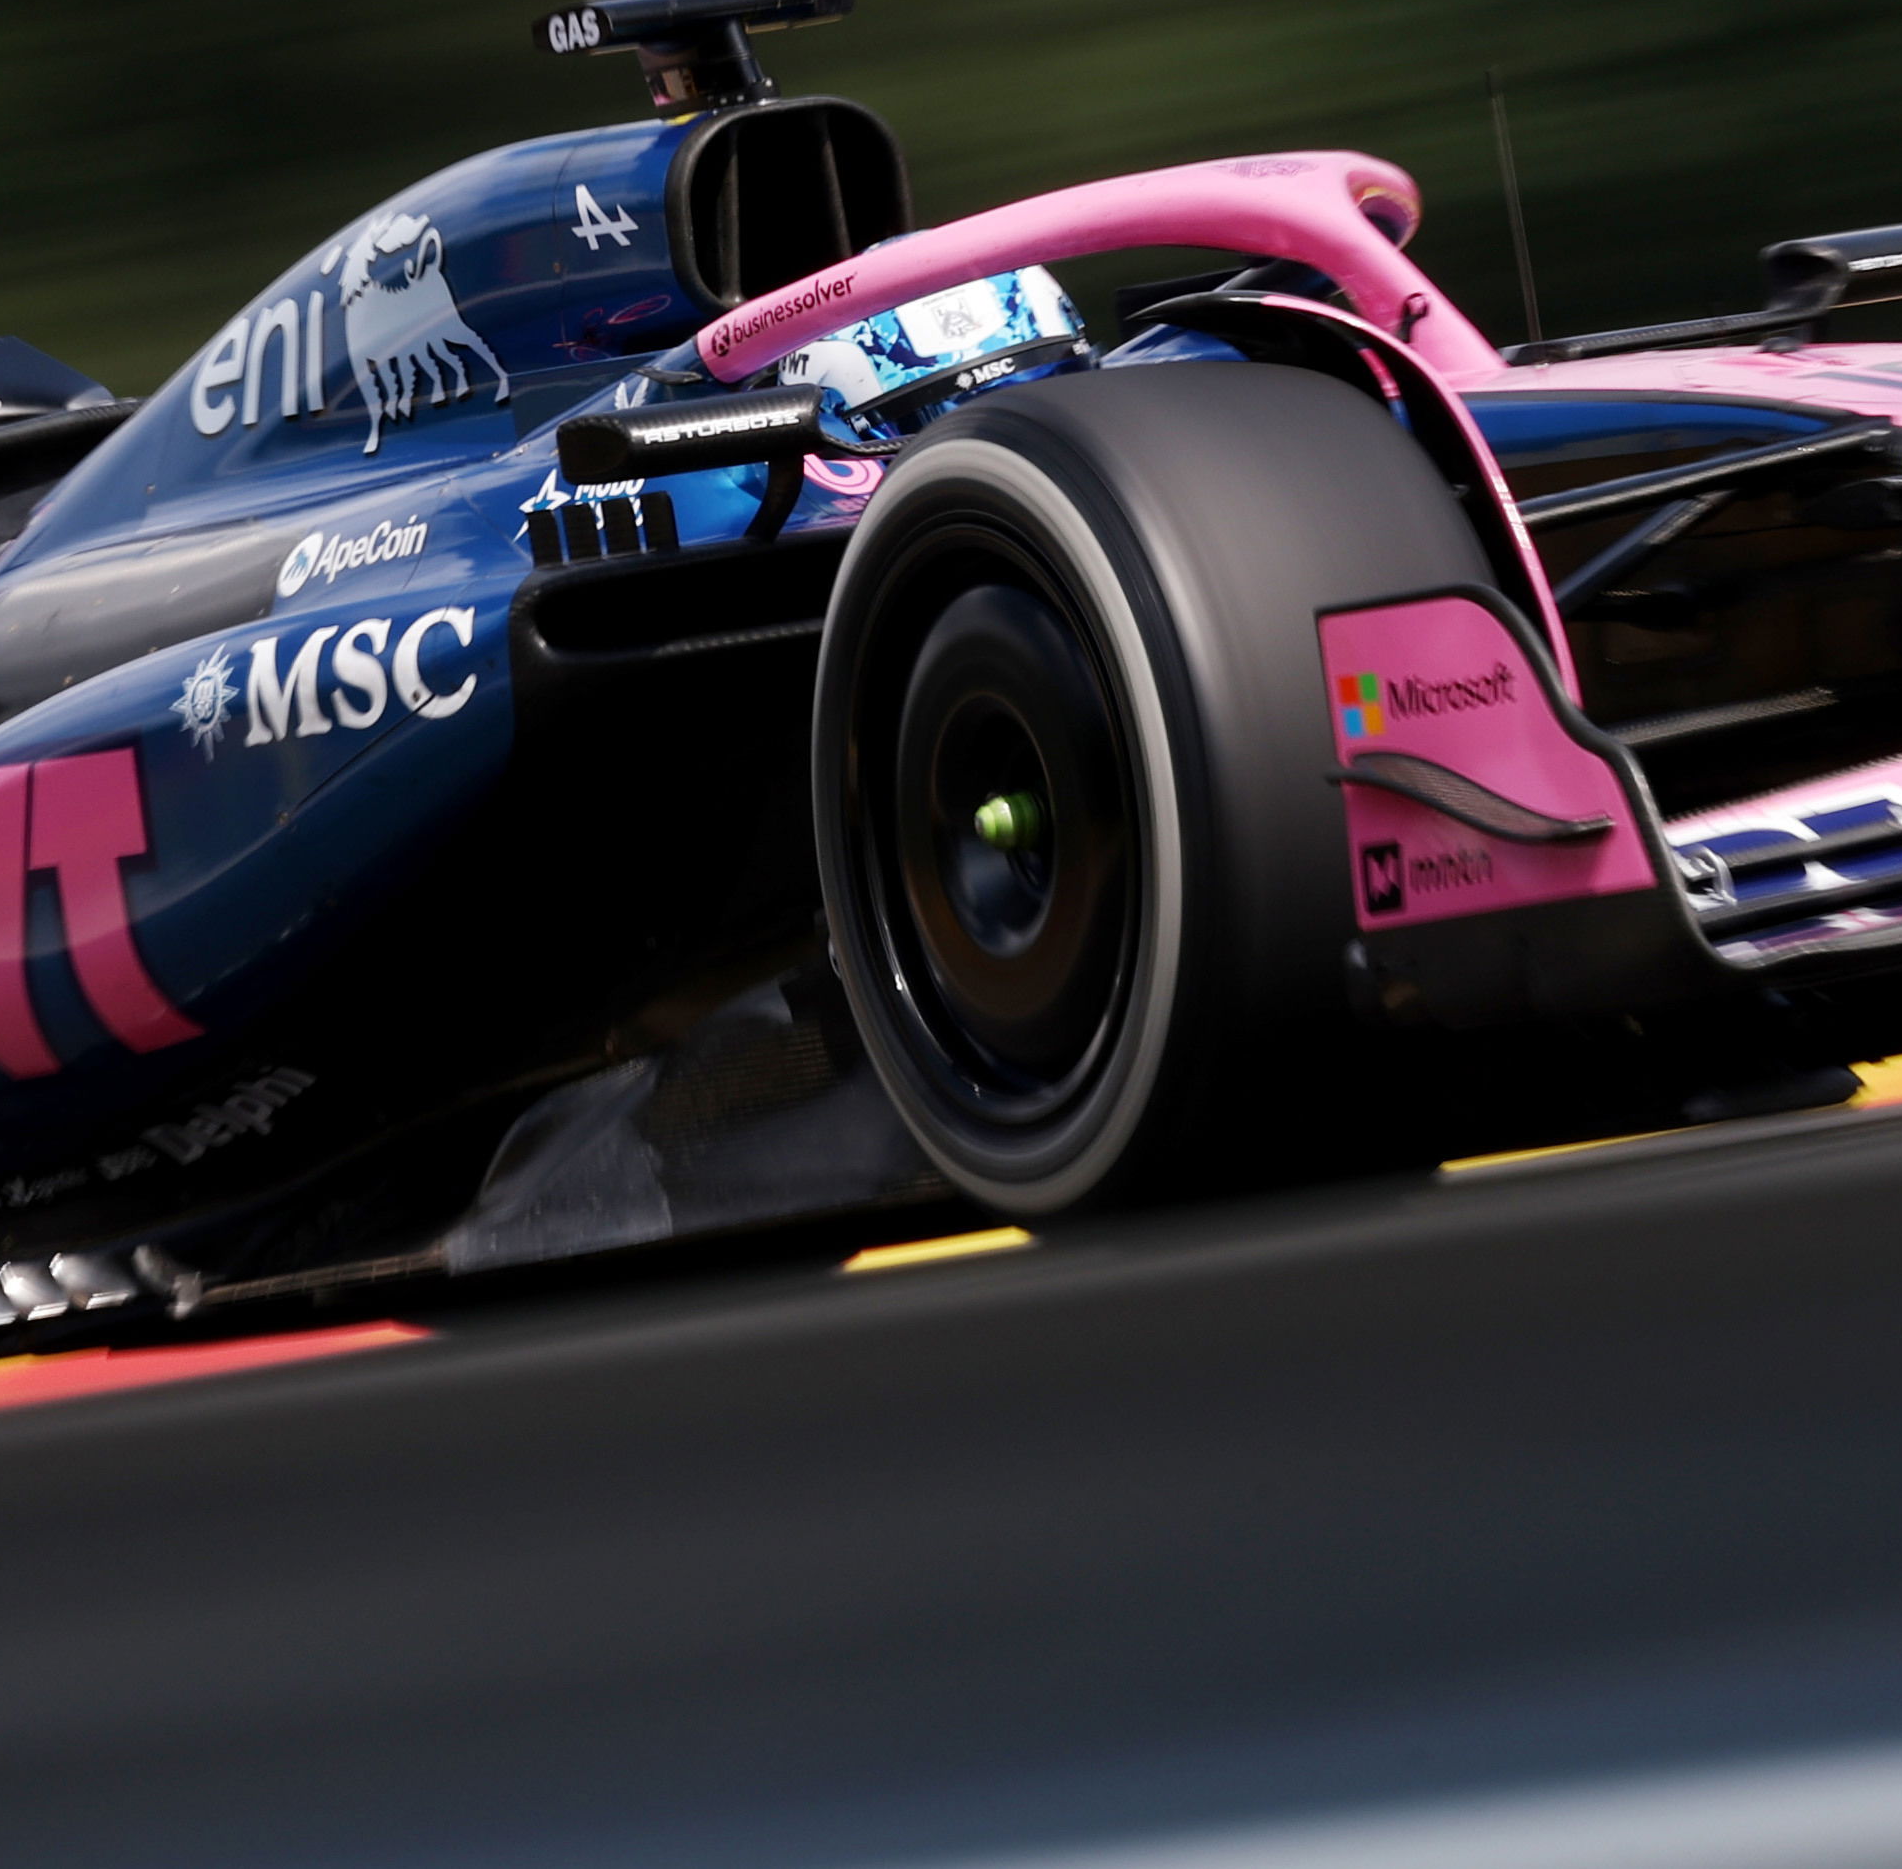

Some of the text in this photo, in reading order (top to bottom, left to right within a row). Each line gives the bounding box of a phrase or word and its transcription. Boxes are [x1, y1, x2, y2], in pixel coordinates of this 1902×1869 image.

[548, 8, 600, 53] GAS
[191, 245, 341, 436] eni
[733, 275, 855, 344] businessolver
[971, 357, 1017, 386] MSC
[311, 514, 428, 585] ApeCoin
[243, 605, 477, 748] MSC
[1386, 660, 1517, 721] Microsoft
